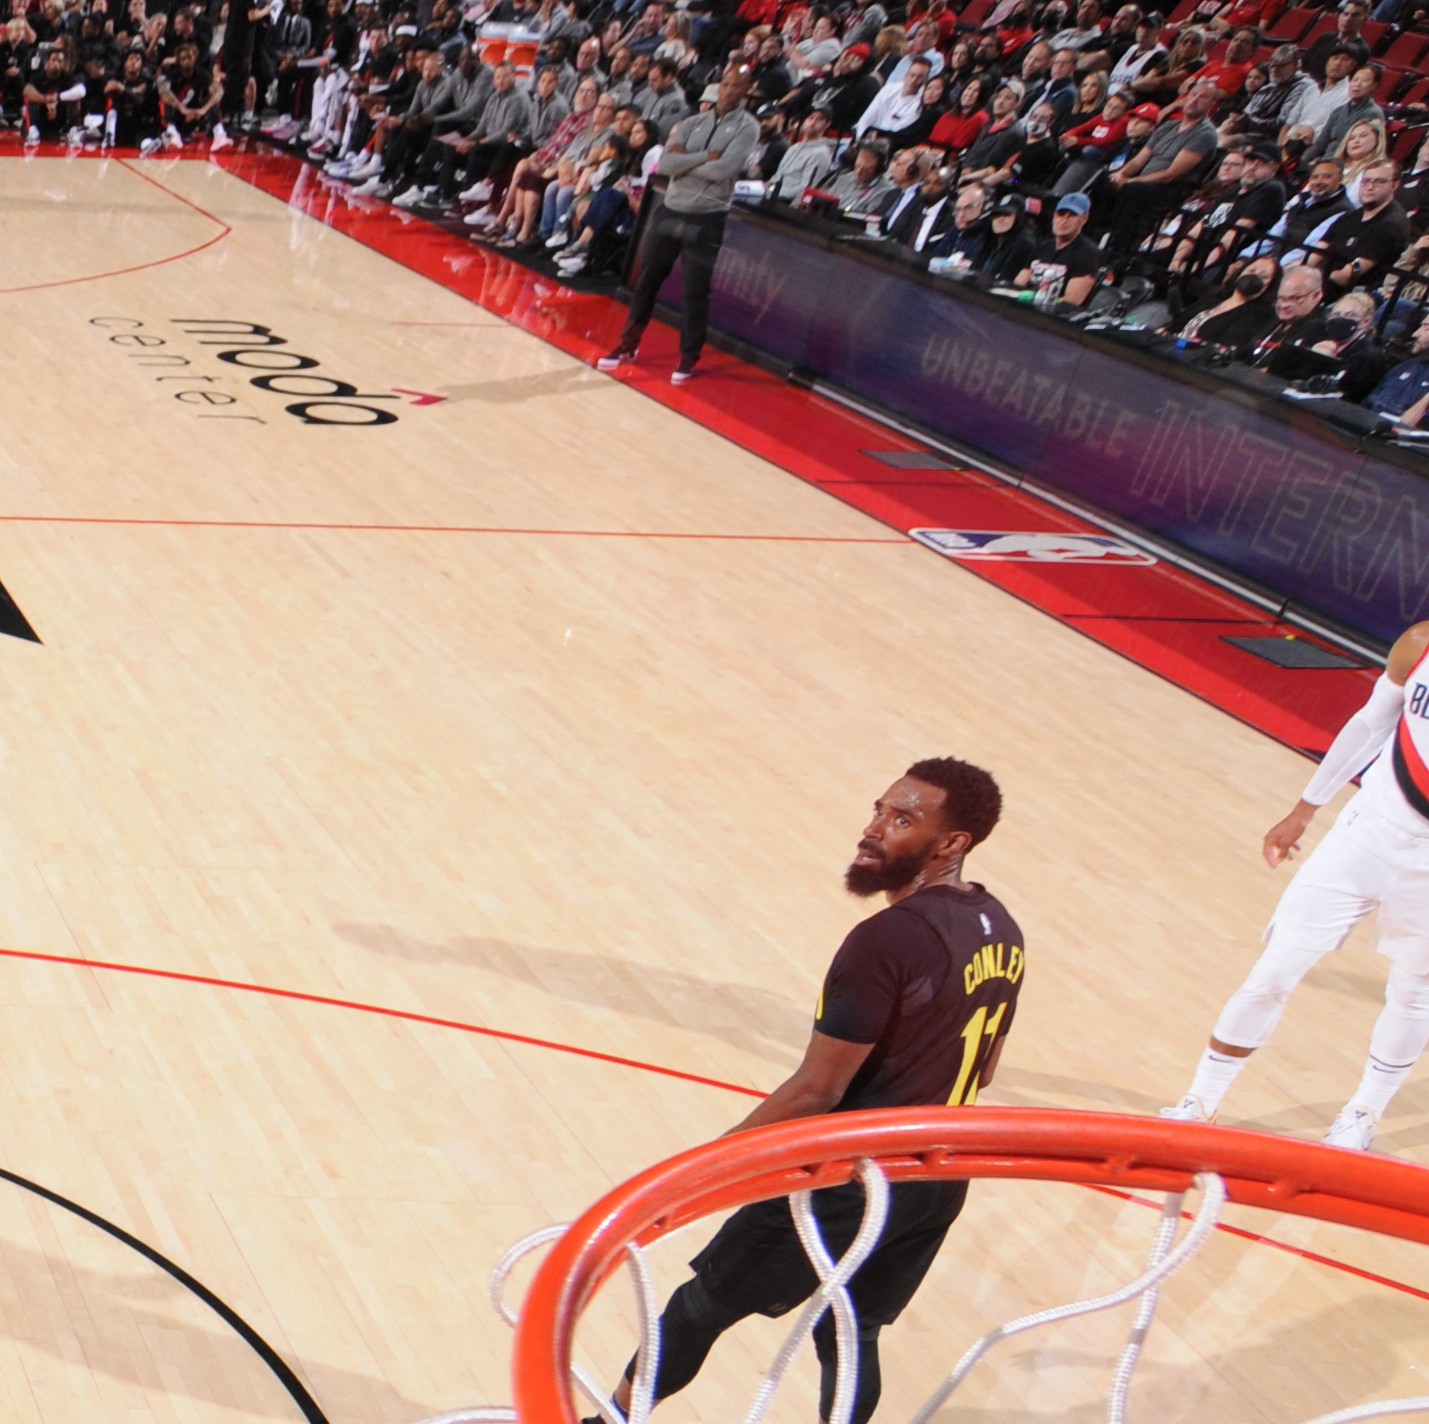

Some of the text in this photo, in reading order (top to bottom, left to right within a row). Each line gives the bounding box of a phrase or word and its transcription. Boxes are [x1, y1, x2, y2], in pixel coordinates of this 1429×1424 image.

[88, 316, 267, 424] center
[169, 318, 402, 426] moda
[920, 333, 1139, 460] UNBEATABLE
[963, 942, 1026, 995] CONLEY
